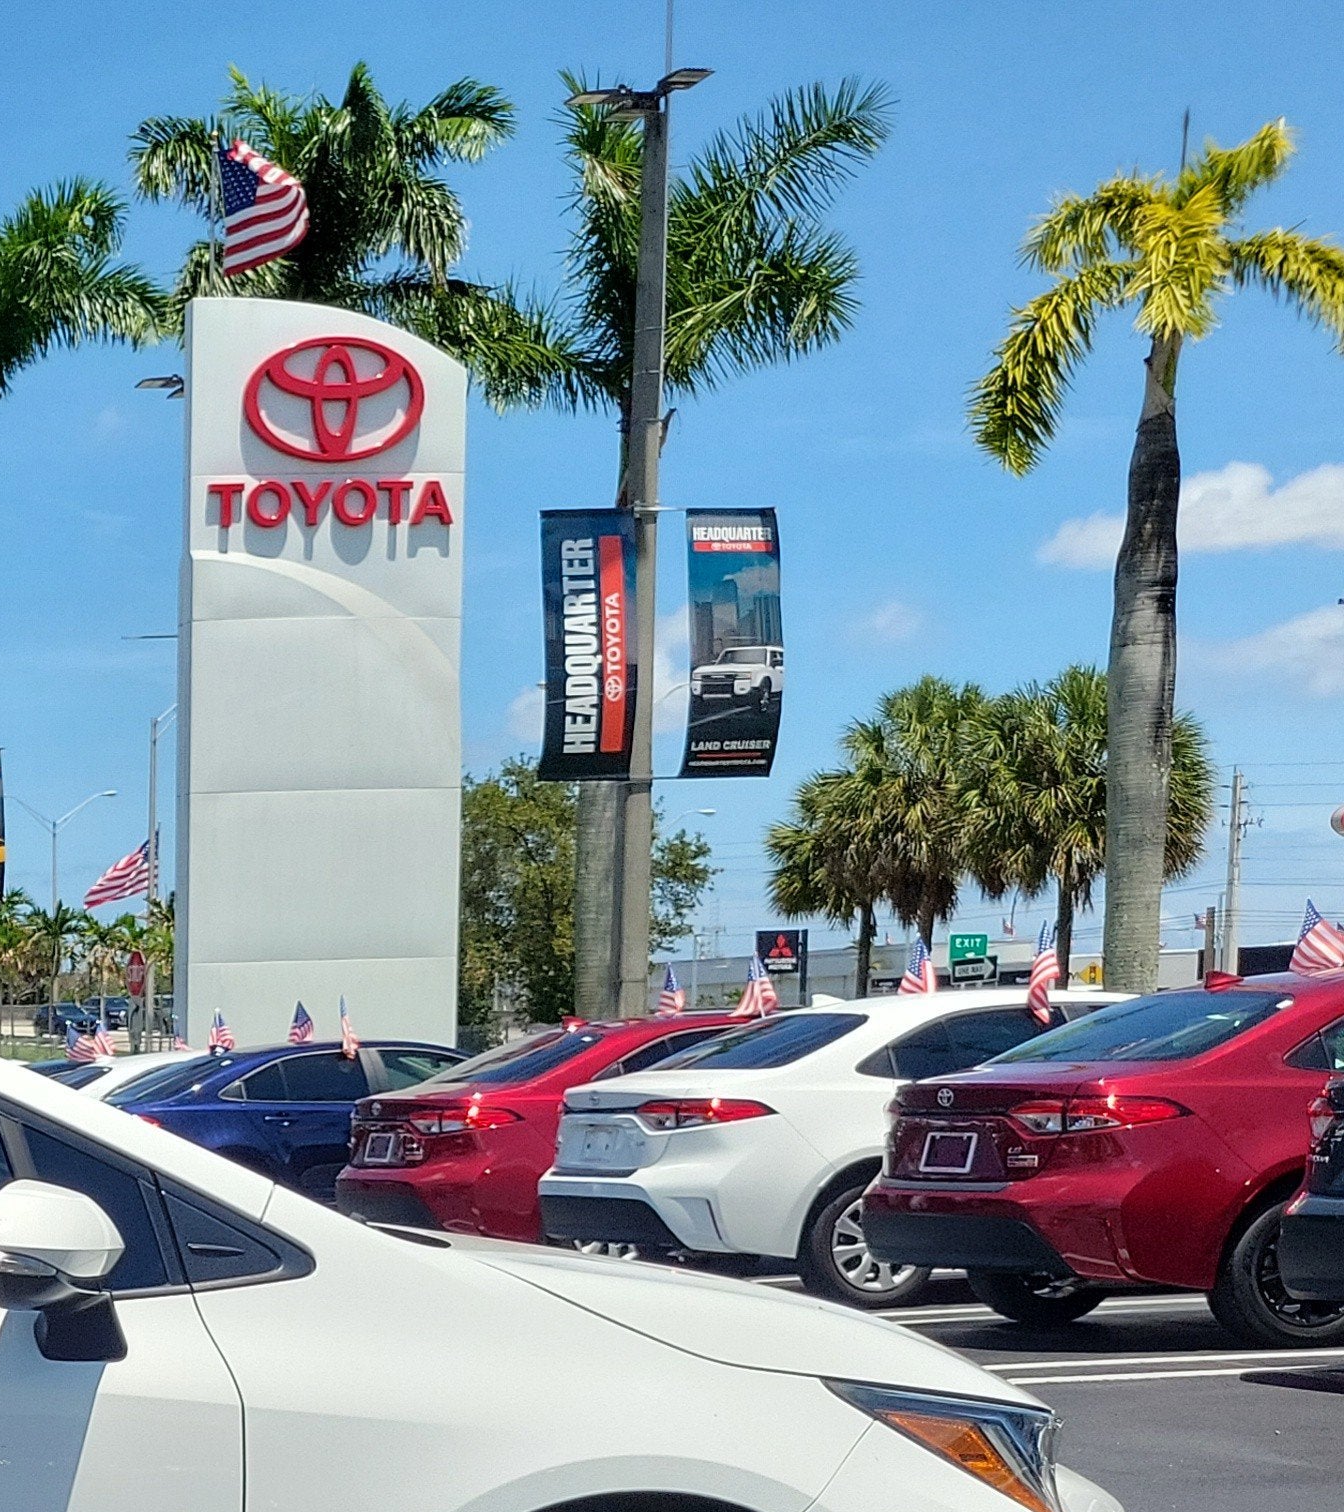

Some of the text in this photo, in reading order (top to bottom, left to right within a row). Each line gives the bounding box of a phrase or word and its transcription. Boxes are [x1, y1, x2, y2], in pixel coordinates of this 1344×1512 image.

[207, 480, 453, 528] TOYOTA
[693, 527, 771, 542] HEADQUARTER
[562, 538, 602, 754] HEADQUARTER
[605, 593, 622, 675] TOYOTA
[691, 740, 771, 751] LAND CRUISER
[955, 938, 981, 948] EXIT
